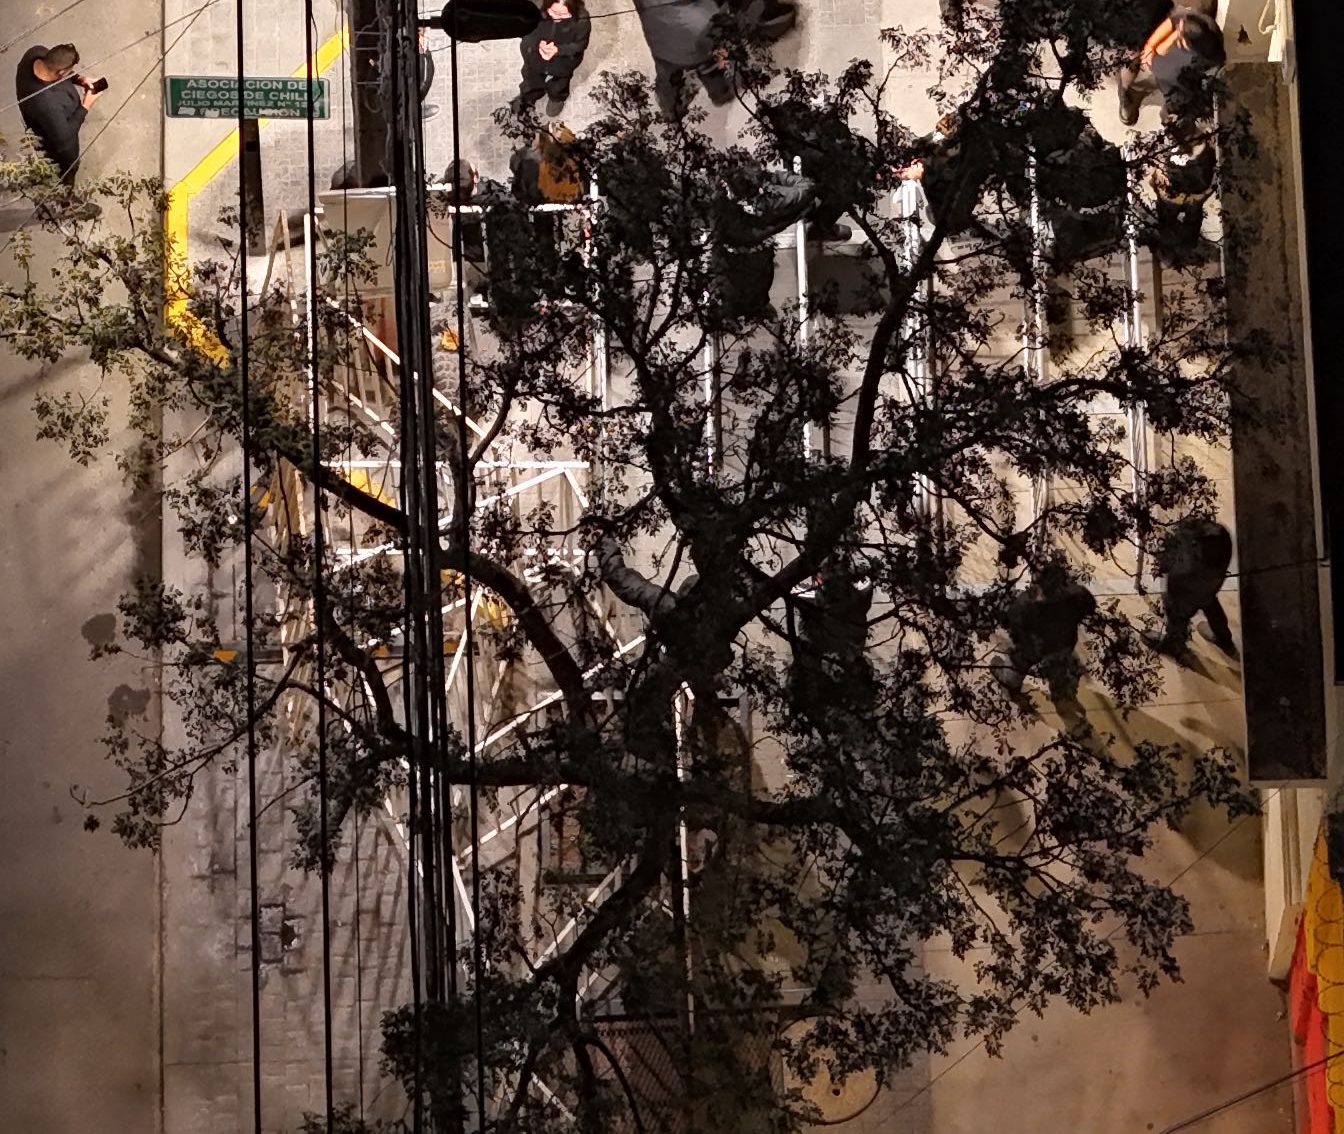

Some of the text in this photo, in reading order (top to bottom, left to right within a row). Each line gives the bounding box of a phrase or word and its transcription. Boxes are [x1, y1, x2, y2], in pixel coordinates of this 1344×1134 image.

[287, 81, 308, 90] DE
[181, 90, 239, 99] CIEGOS
[243, 91, 264, 100] DE
